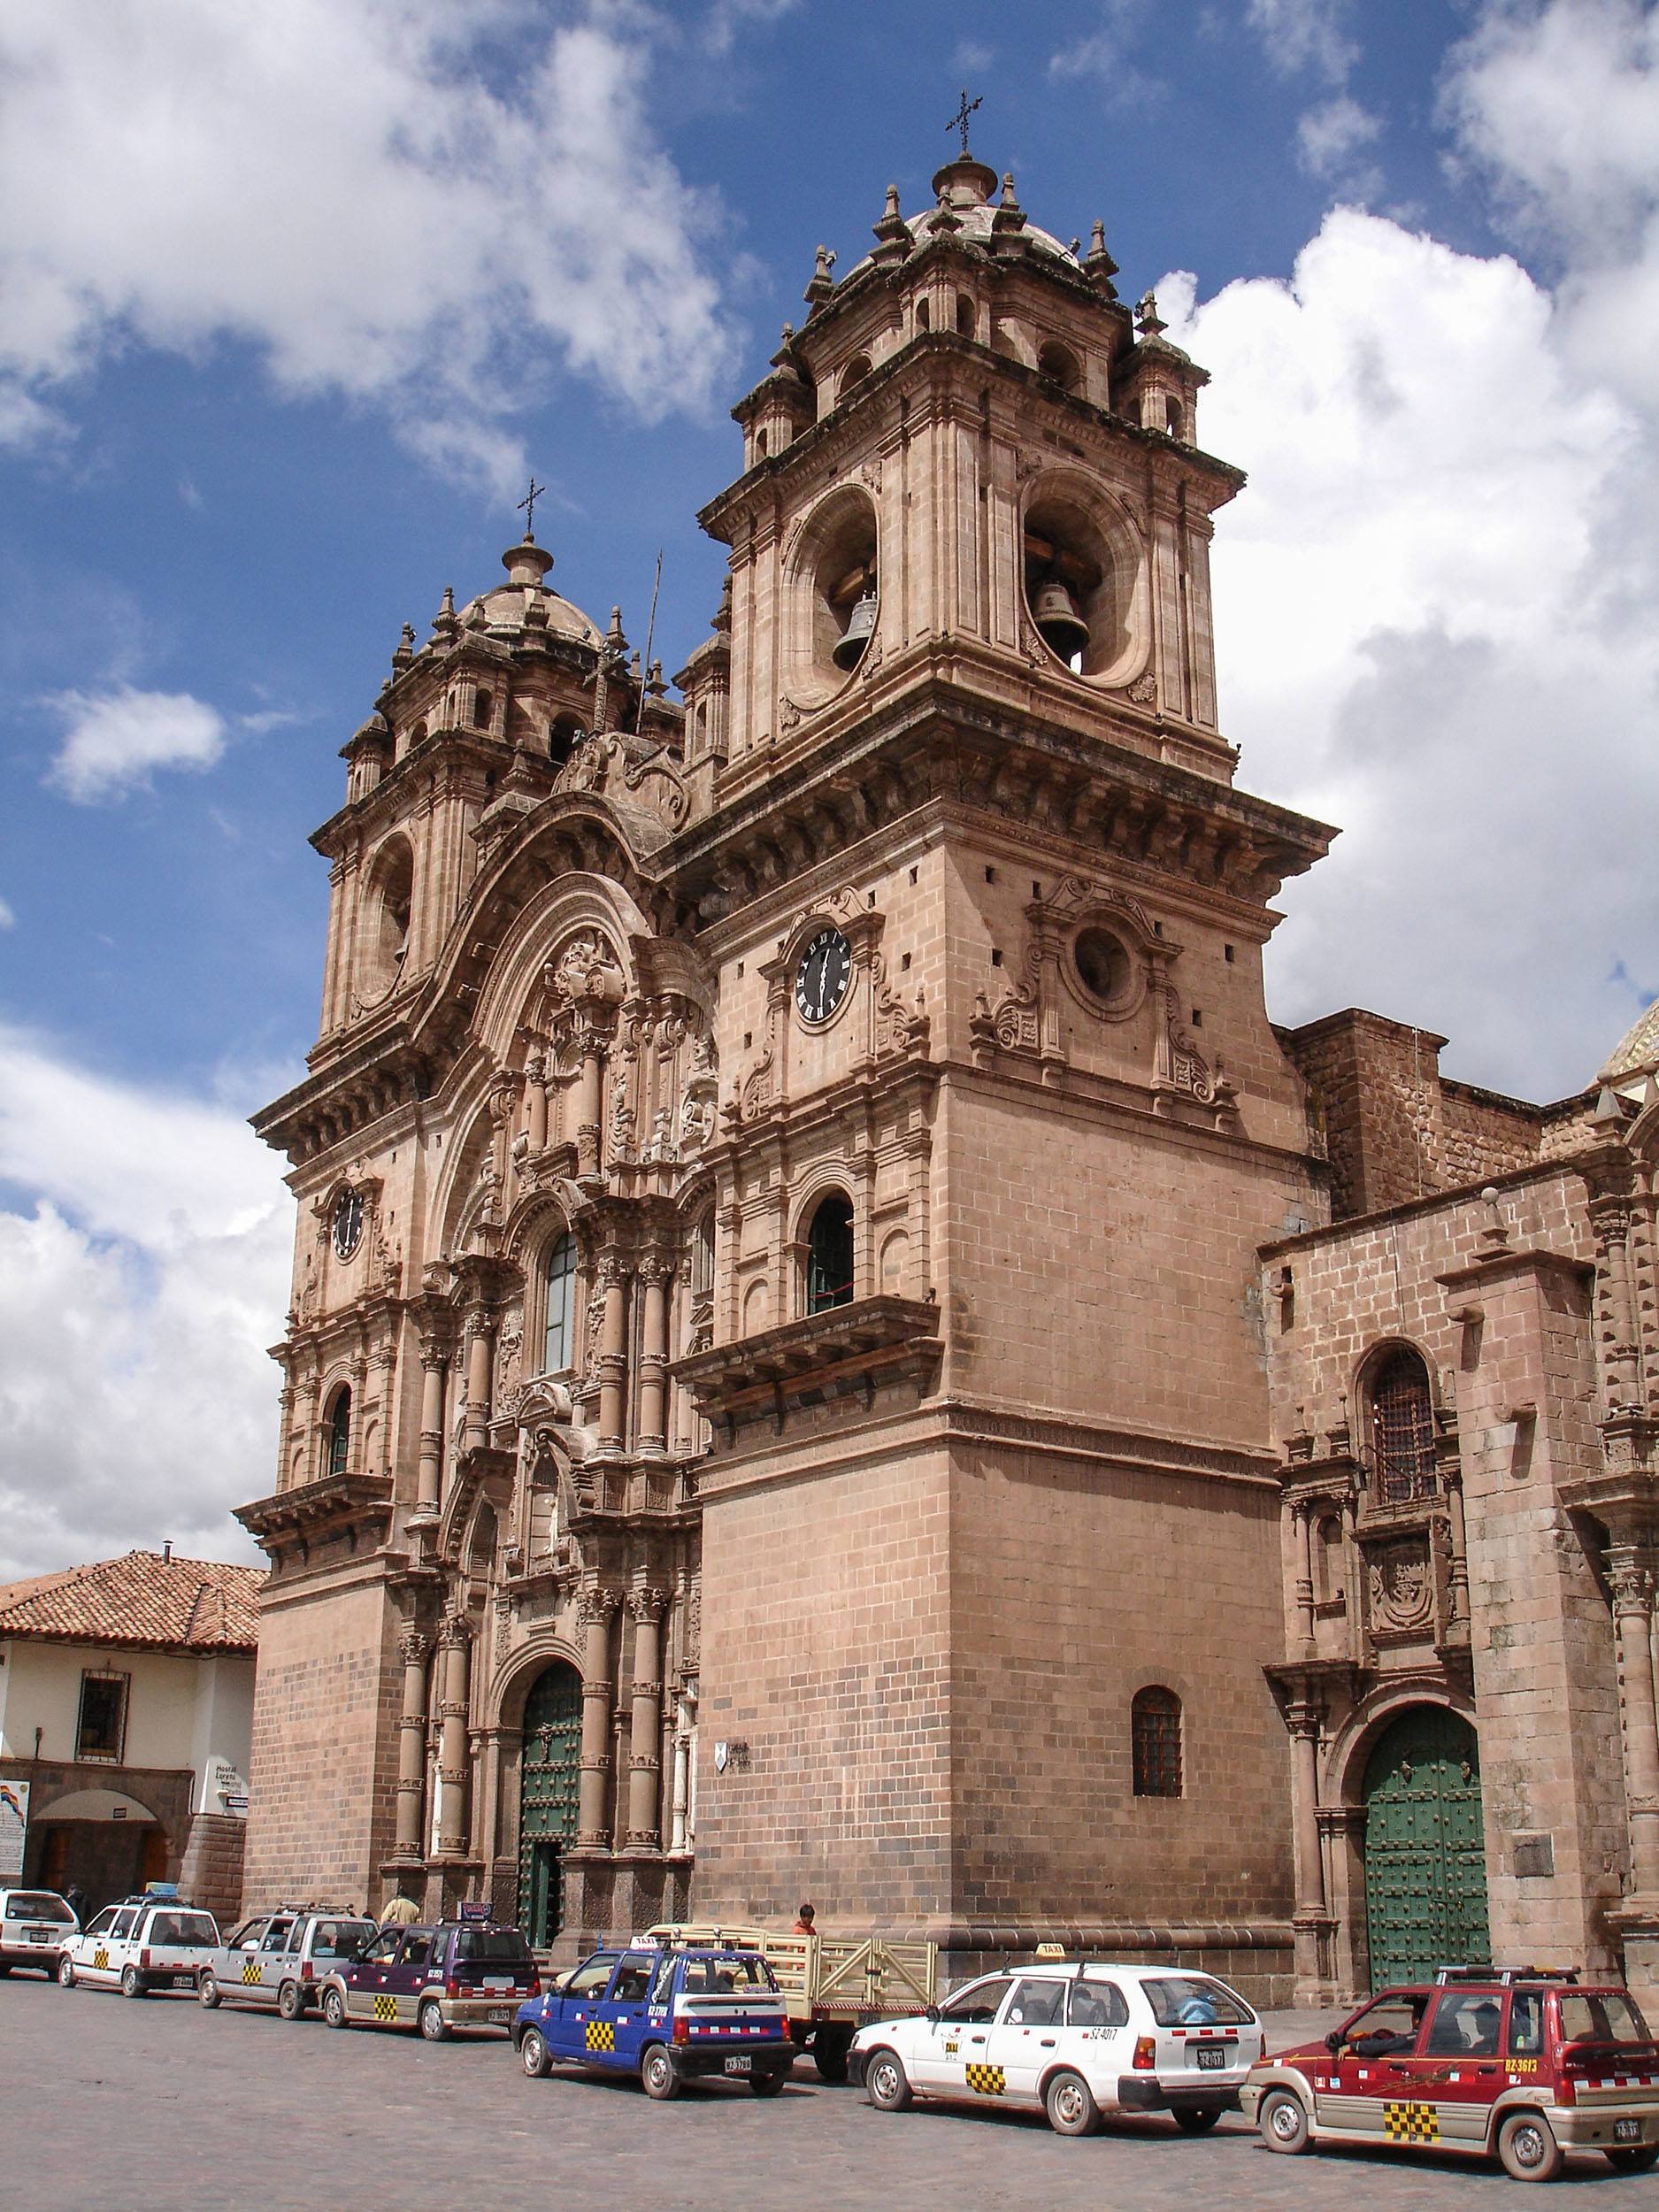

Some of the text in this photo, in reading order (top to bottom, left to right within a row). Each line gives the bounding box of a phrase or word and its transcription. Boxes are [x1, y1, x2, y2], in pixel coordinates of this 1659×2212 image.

[832, 932, 837, 943] I
[809, 942, 817, 955] XI
[801, 960, 809, 970] X
[796, 976, 804, 987] IX
[828, 997, 836, 1009] V
[1042, 1945, 1063, 1954] TAXI
[1505, 2059, 1537, 2072] BZ-3613
